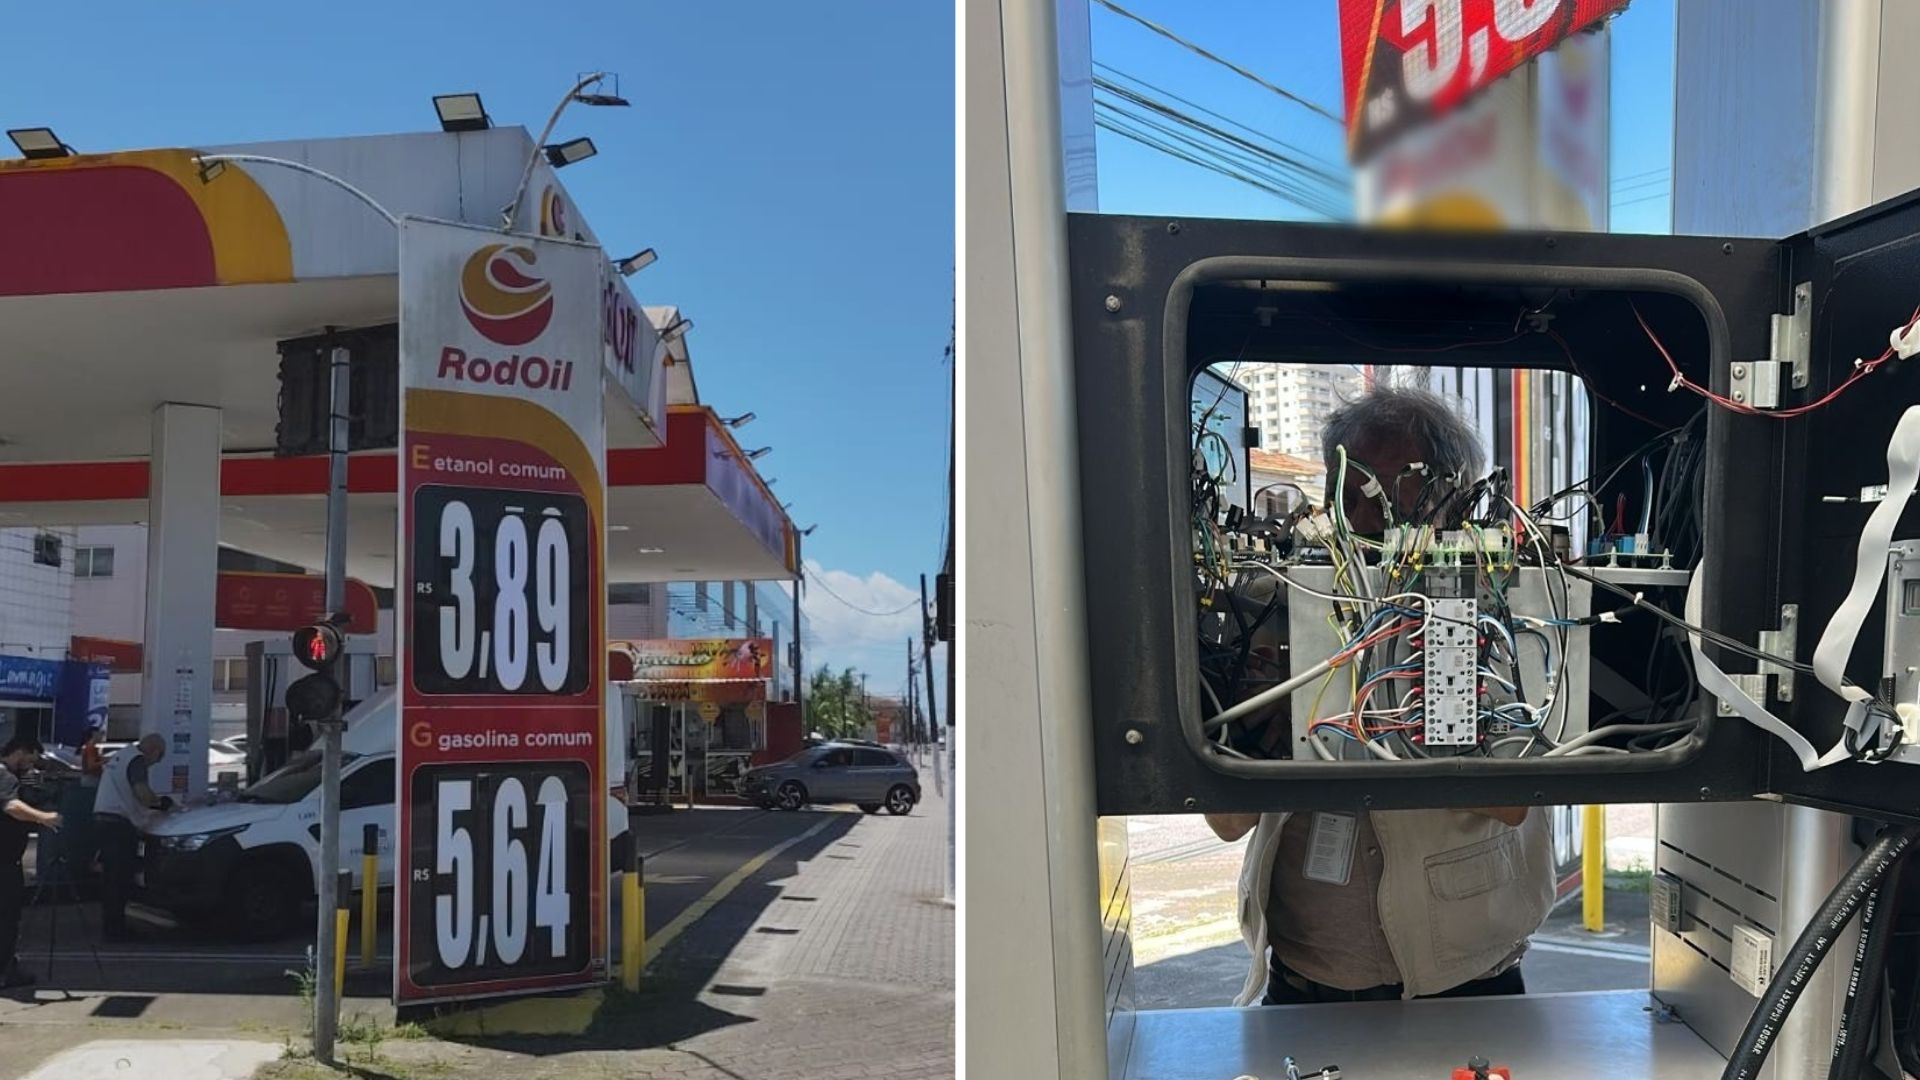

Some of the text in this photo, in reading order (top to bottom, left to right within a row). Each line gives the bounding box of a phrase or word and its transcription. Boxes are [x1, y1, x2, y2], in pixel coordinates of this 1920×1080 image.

[437, 346, 573, 391] RodOil
[412, 444, 566, 480] E etanol comum
[439, 500, 570, 692] 3,89
[411, 721, 592, 751] G gasolina comum
[435, 776, 570, 969] 5,64
[1752, 1024, 1774, 1055] 105BAR
